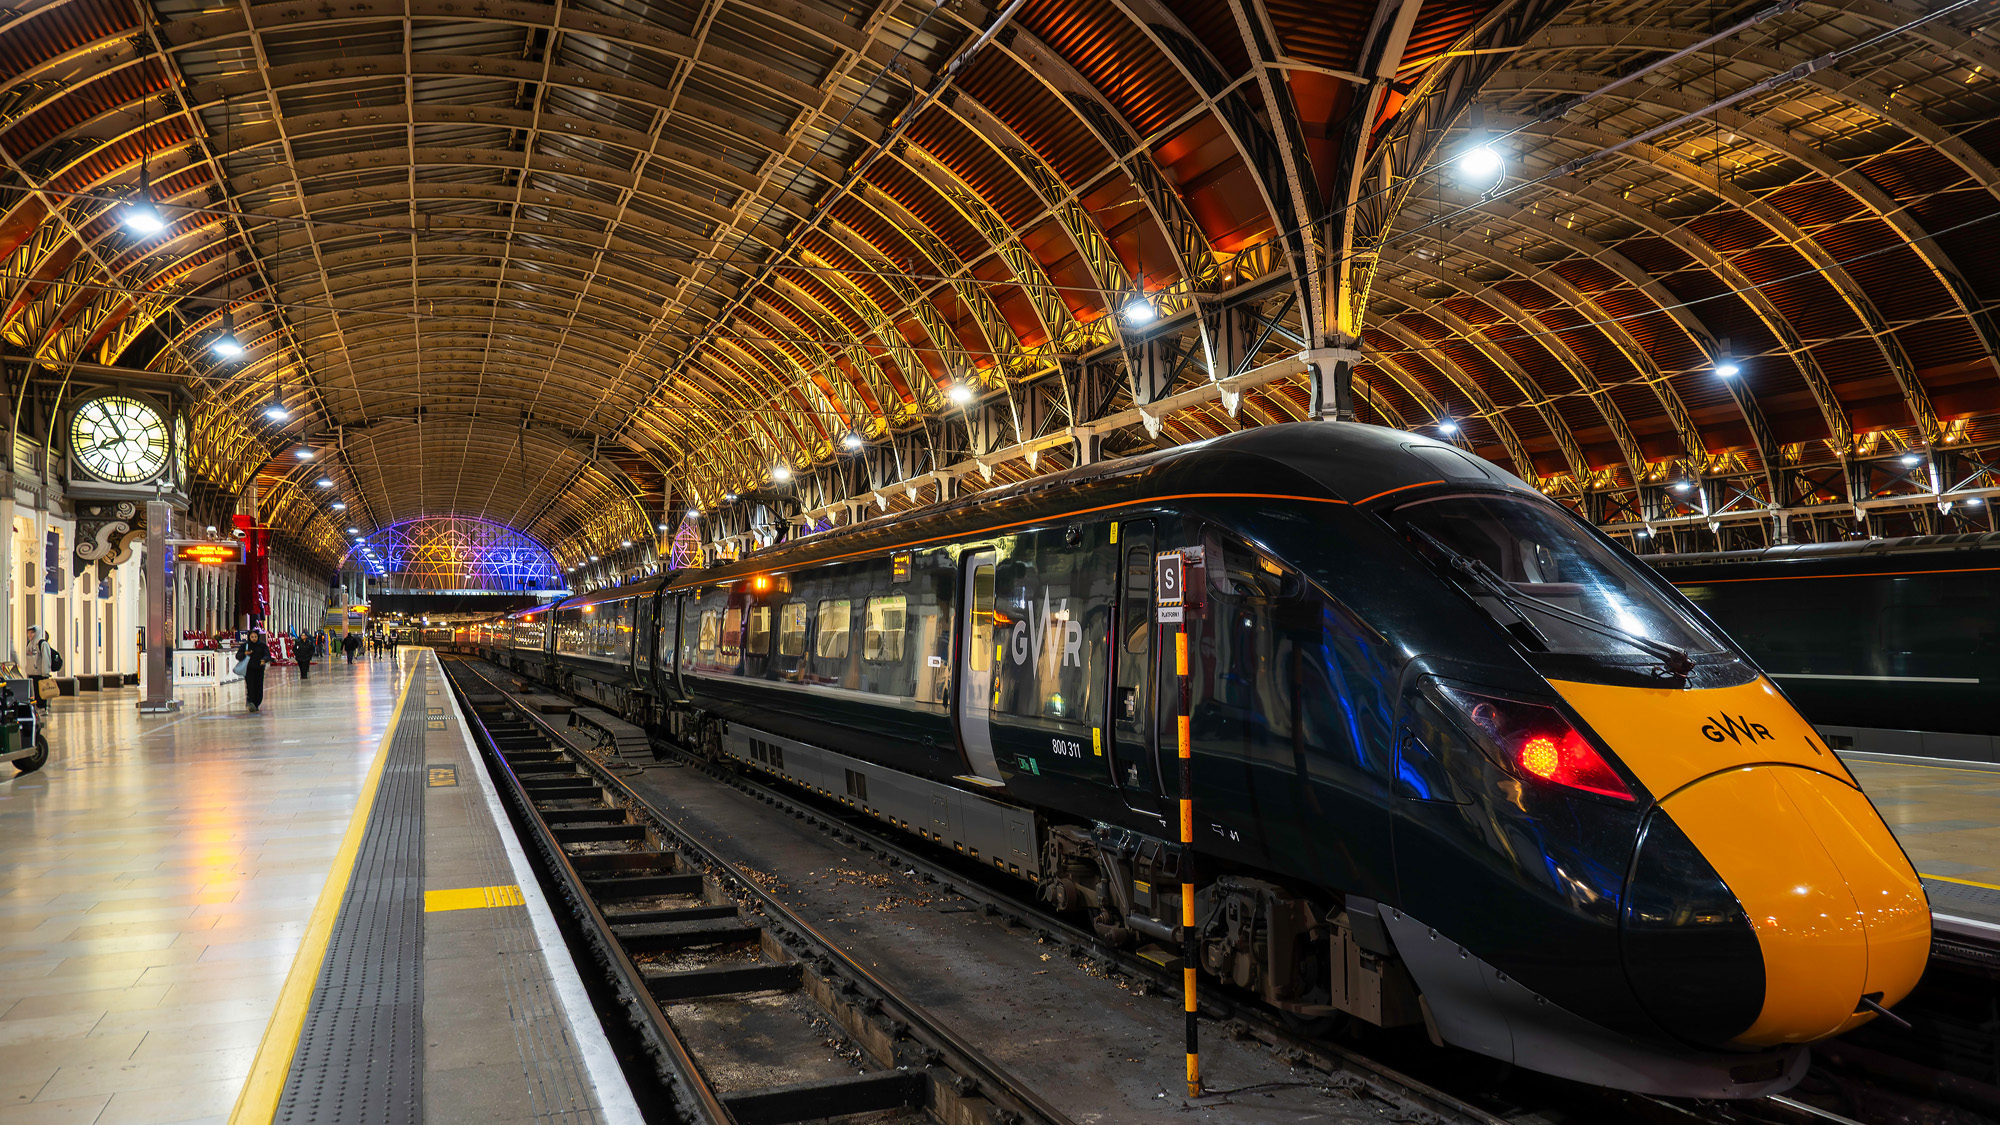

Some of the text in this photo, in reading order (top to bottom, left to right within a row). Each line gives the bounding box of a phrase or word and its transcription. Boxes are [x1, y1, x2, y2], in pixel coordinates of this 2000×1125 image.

[1165, 568, 1174, 589] S
[1012, 584, 1083, 680] GWR
[1701, 710, 1776, 746] GWR
[1052, 738, 1080, 758] 800 311
